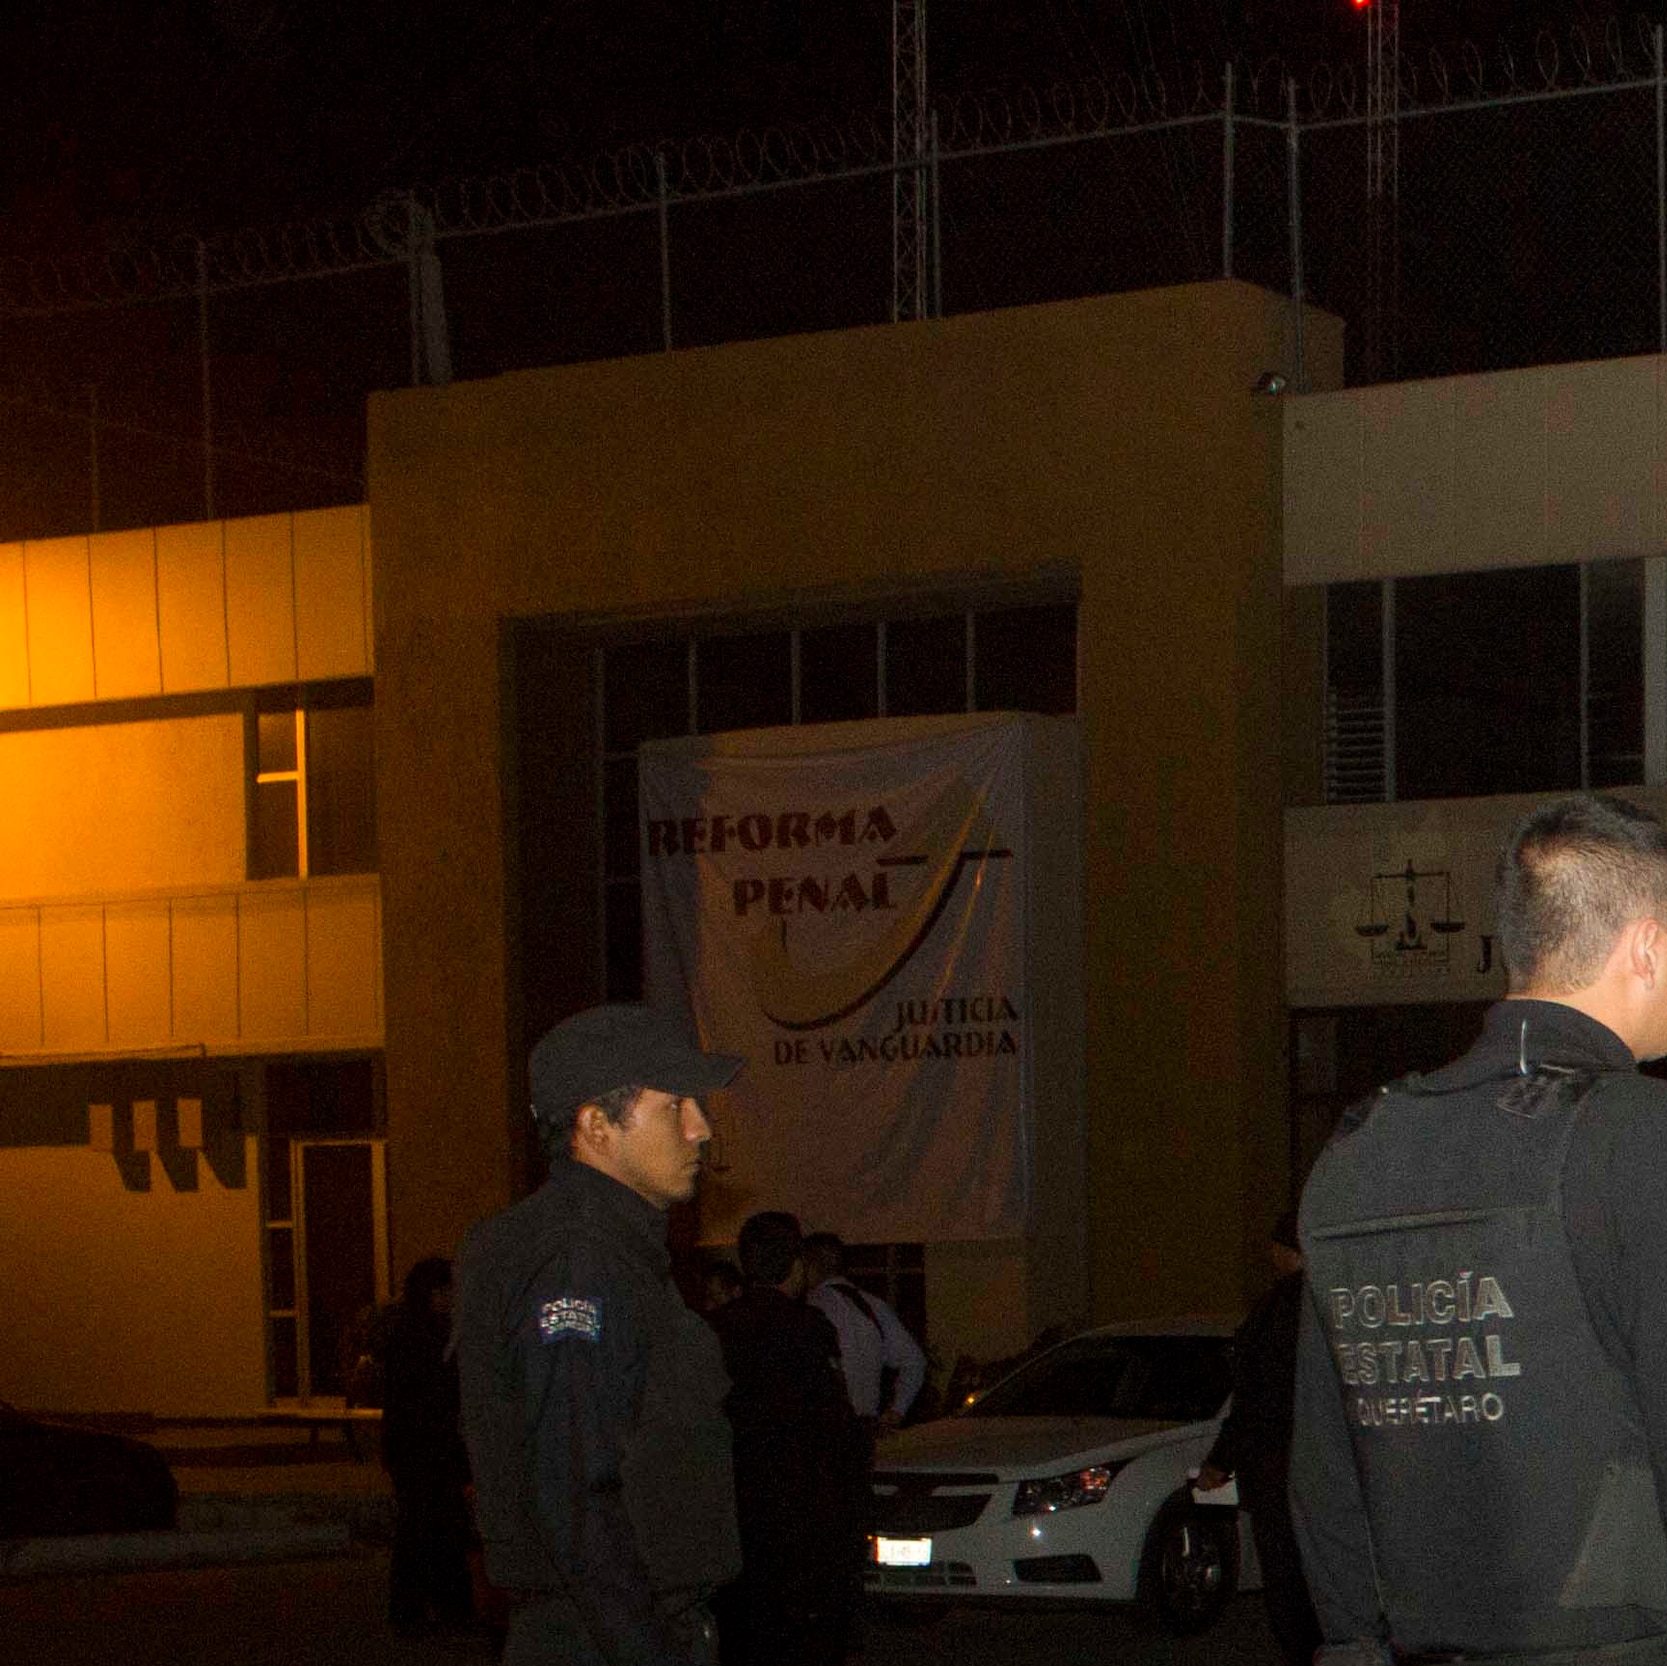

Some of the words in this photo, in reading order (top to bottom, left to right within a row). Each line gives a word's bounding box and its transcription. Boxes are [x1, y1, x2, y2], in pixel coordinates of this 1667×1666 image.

[647, 805, 898, 857] REFORMA
[733, 872, 897, 916] PENAL
[893, 996, 1020, 1034] JUTICIA
[774, 1039, 808, 1065] DE
[819, 1030, 1018, 1065] VANGUARDIA
[1328, 1271, 1514, 1329] POLICÍA
[1337, 1334, 1521, 1385] ESTATAL
[1357, 1388, 1504, 1427] QUERÉTARO
